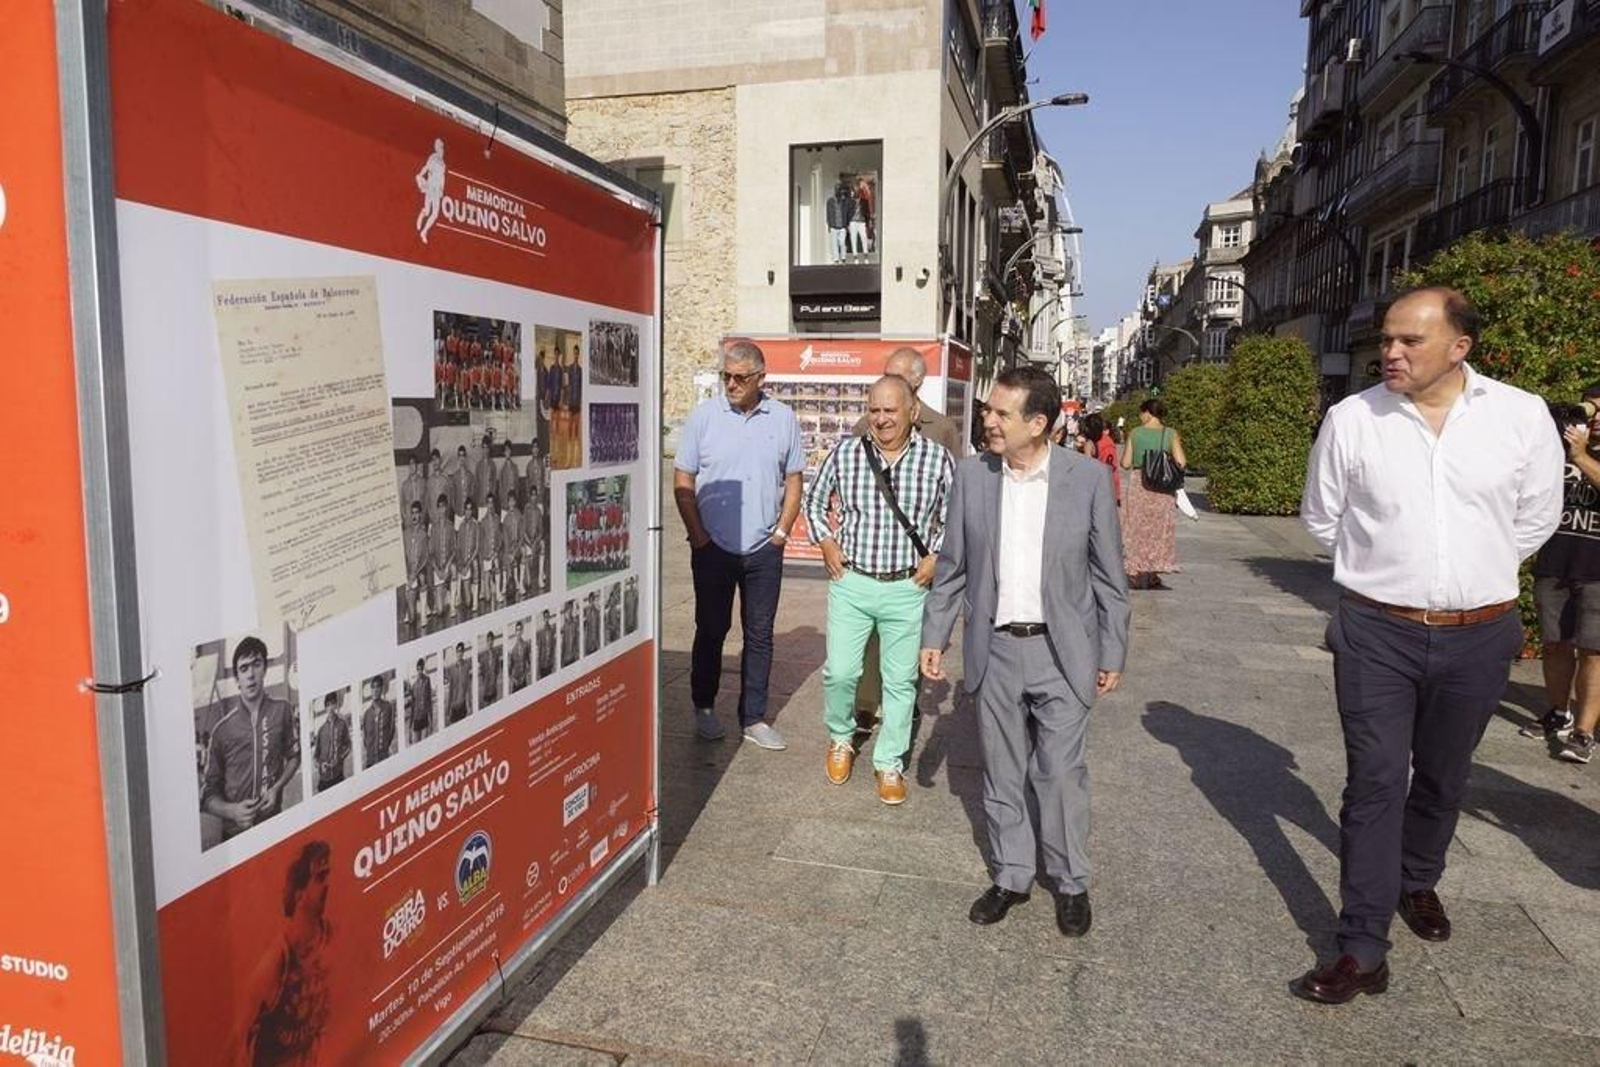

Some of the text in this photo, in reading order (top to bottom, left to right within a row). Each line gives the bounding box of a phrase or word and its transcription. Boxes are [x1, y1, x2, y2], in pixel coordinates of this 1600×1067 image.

[441, 196, 546, 247] QUINO SALVO
[466, 185, 526, 219] MEMORIAL
[379, 801, 400, 830] IV
[405, 750, 492, 814] MEMORIAL
[353, 803, 442, 879] QUINO
[446, 760, 510, 819] SALVO
[462, 867, 487, 897] ALBA
[384, 889, 425, 939] OBRA
[1, 954, 68, 981] STUDIO
[369, 992, 405, 1031] Martes
[408, 977, 420, 995] 10
[421, 966, 433, 984] de
[435, 922, 484, 971] Septiembre
